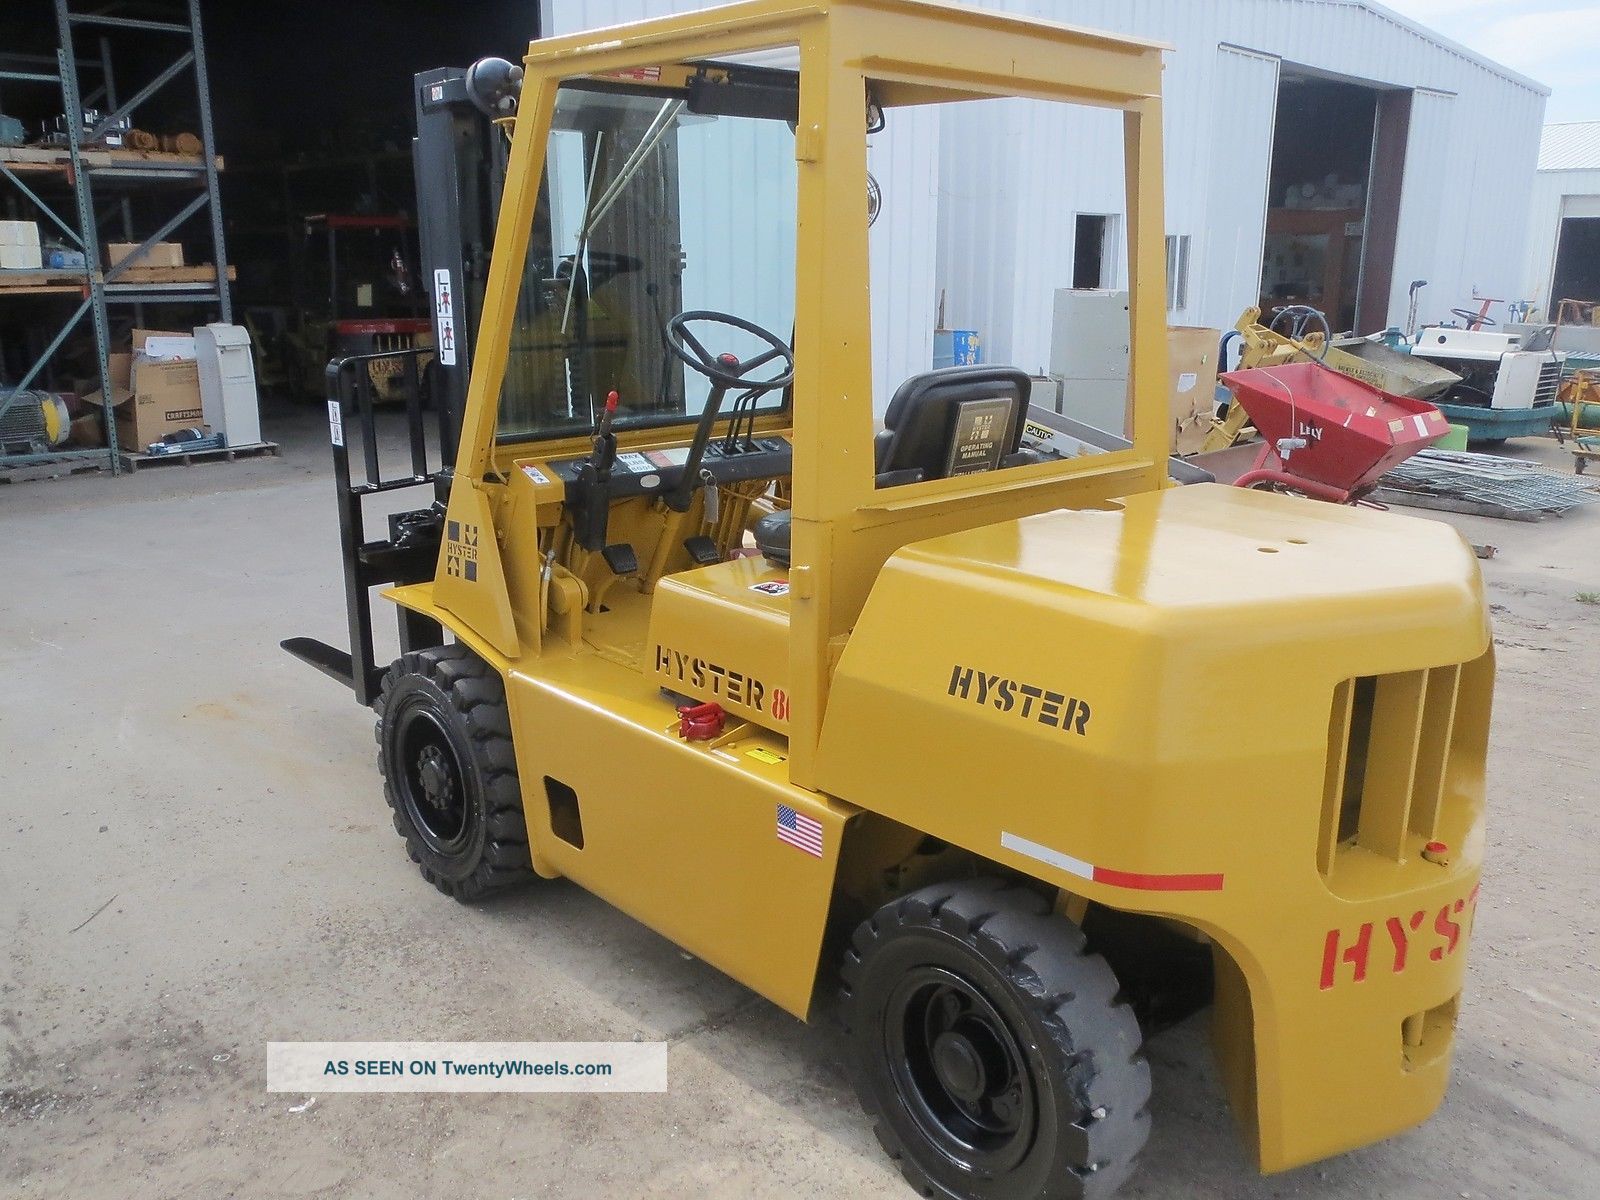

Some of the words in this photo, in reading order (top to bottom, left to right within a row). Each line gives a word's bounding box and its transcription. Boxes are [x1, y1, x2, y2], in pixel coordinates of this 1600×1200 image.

[166, 409, 202, 420] CRAFTSMA
[1300, 422, 1322, 440] LELY
[960, 442, 993, 453] OPERATING
[962, 451, 986, 459] MANUAL
[447, 542, 478, 560] HYSTER
[656, 644, 764, 712] HYSTER
[948, 665, 1091, 736] HYSTER
